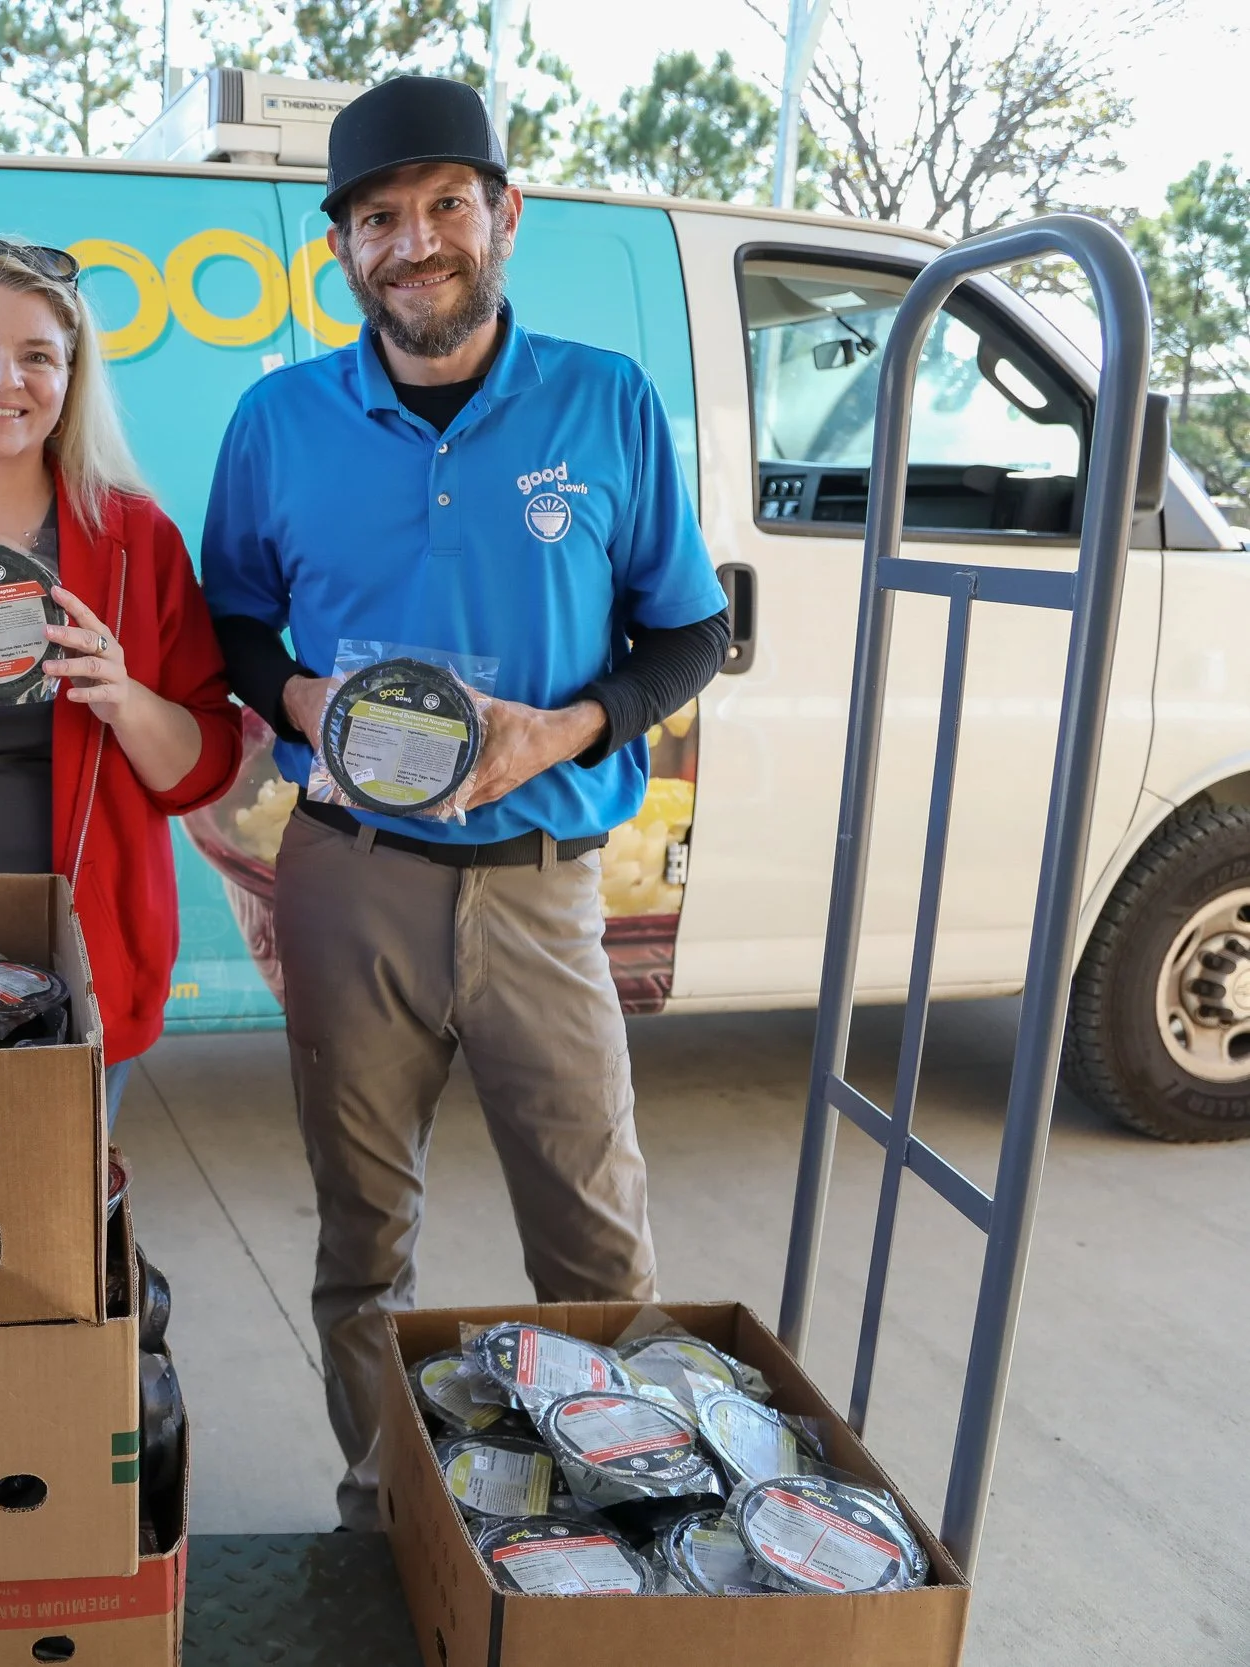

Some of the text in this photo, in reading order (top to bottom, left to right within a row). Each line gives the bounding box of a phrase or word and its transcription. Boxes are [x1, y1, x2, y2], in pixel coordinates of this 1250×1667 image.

[282, 99, 326, 112] THERMO
[516, 461, 568, 495] good
[557, 481, 588, 495] bowls
[379, 688, 405, 700] good
[395, 695, 412, 703] bowls
[370, 705, 392, 716] Chicken
[392, 710, 403, 718] and
[403, 712, 429, 723] Buttered
[429, 718, 453, 728] Noodles
[801, 1489, 832, 1504] good
[797, 1500, 871, 1540] Chicken Country Captain
[38, 1595, 120, 1618] PREMIUM
